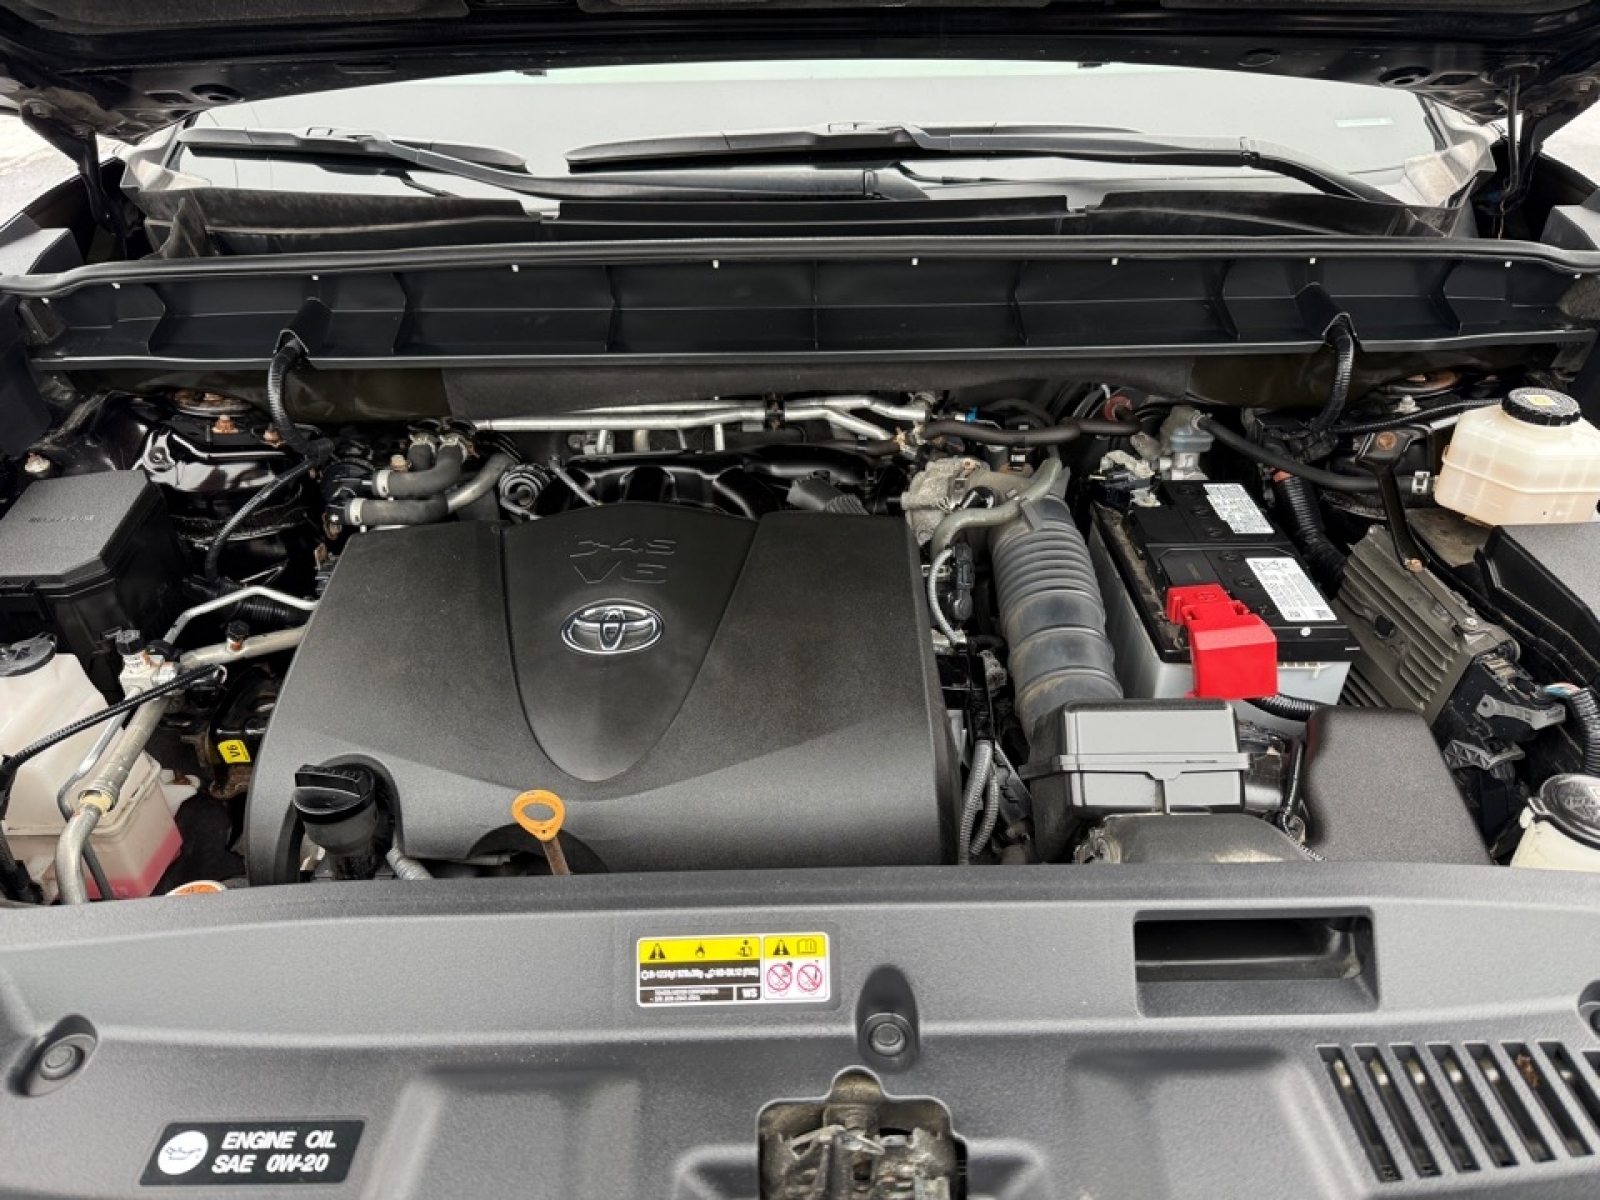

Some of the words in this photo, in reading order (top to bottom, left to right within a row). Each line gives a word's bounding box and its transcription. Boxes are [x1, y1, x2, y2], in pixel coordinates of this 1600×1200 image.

[221, 1131, 298, 1150] ENGINE
[305, 1130, 337, 1148] OIL
[212, 1154, 256, 1173] SAE
[265, 1153, 330, 1172] 0W-20
